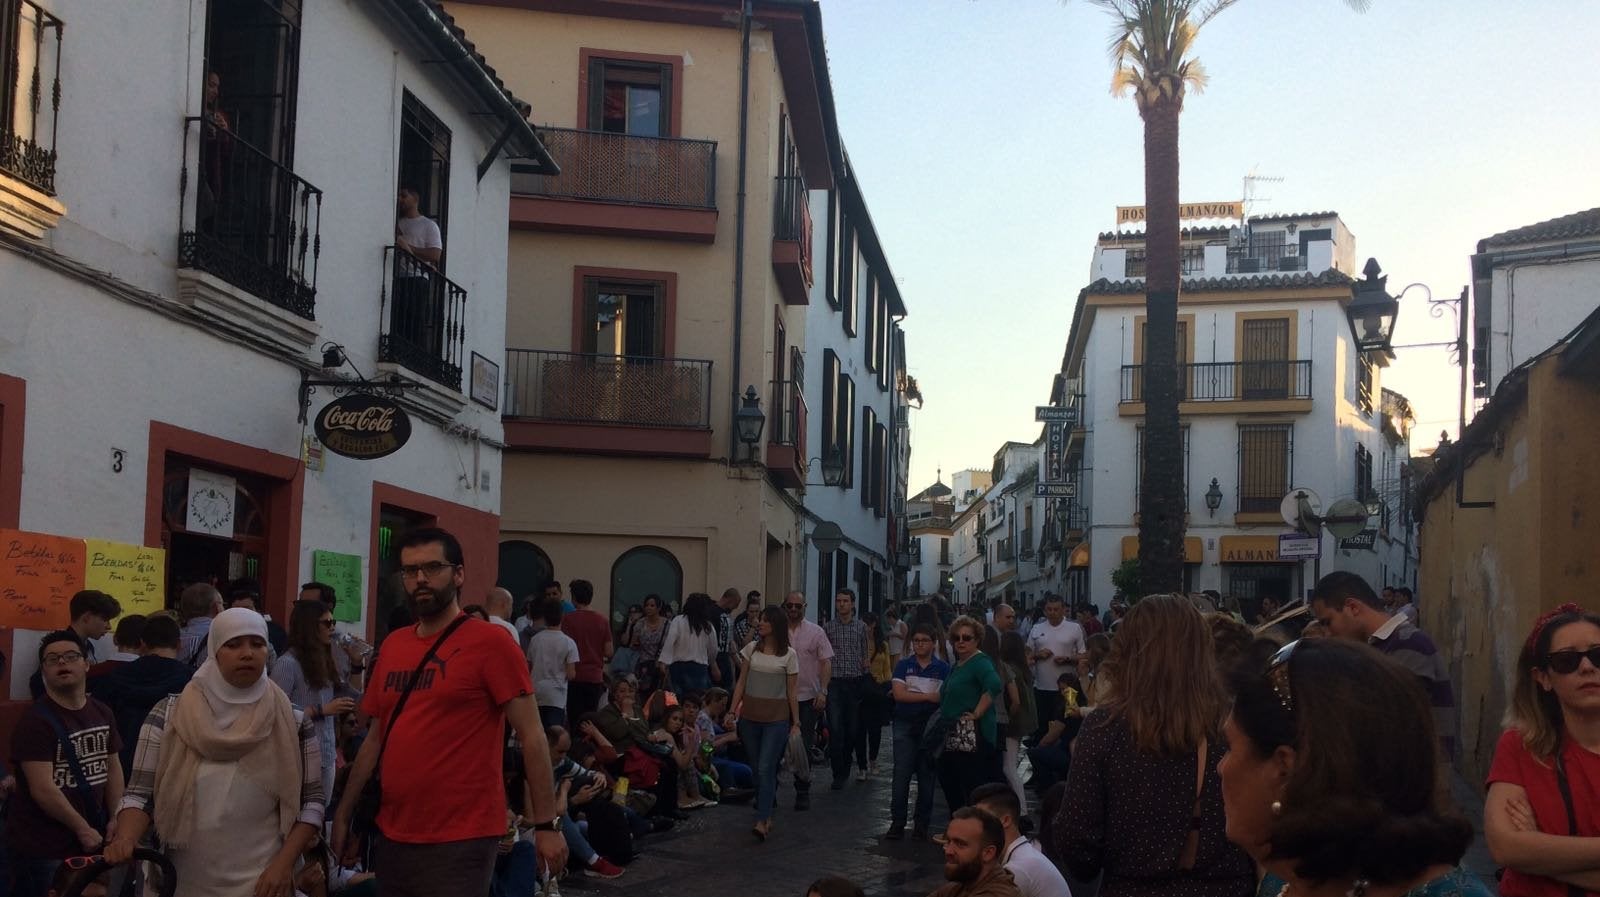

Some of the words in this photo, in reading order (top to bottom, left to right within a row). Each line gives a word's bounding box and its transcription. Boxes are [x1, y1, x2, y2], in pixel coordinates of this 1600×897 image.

[1122, 209, 1145, 220] HOS
[1179, 204, 1235, 217] LMANZOR
[323, 405, 396, 432] Coca-Cola
[1051, 425, 1061, 479] HOSTAL
[113, 451, 123, 473] 3
[1037, 485, 1046, 494] P
[1047, 485, 1074, 494] PARKING
[1227, 549, 1279, 561] ALMAN
